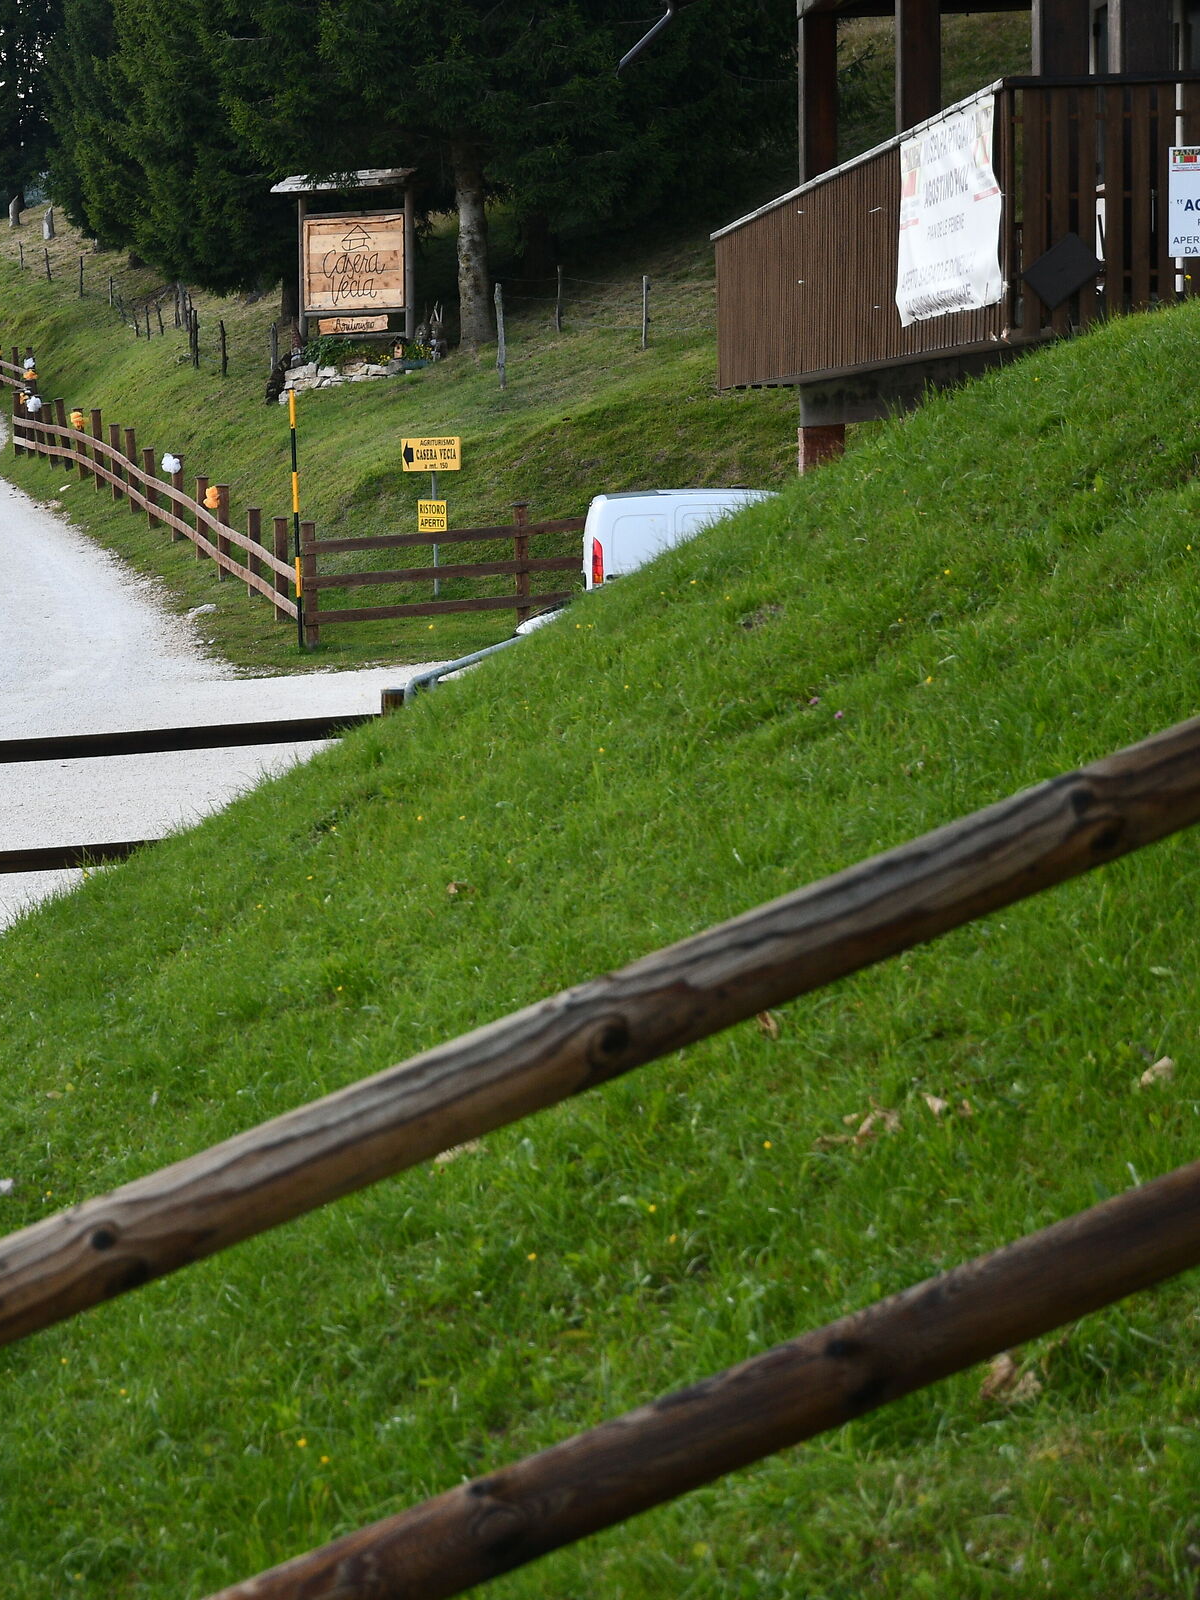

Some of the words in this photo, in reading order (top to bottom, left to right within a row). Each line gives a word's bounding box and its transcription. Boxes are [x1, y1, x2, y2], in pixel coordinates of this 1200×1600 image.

[1184, 246, 1199, 254] DA
[323, 249, 386, 279] Casera
[331, 275, 378, 306] Vecia
[415, 448, 437, 460] CASERA
[439, 448, 457, 460] VECIA
[420, 504, 446, 515] RISTORO
[420, 518, 445, 528] APERTO
